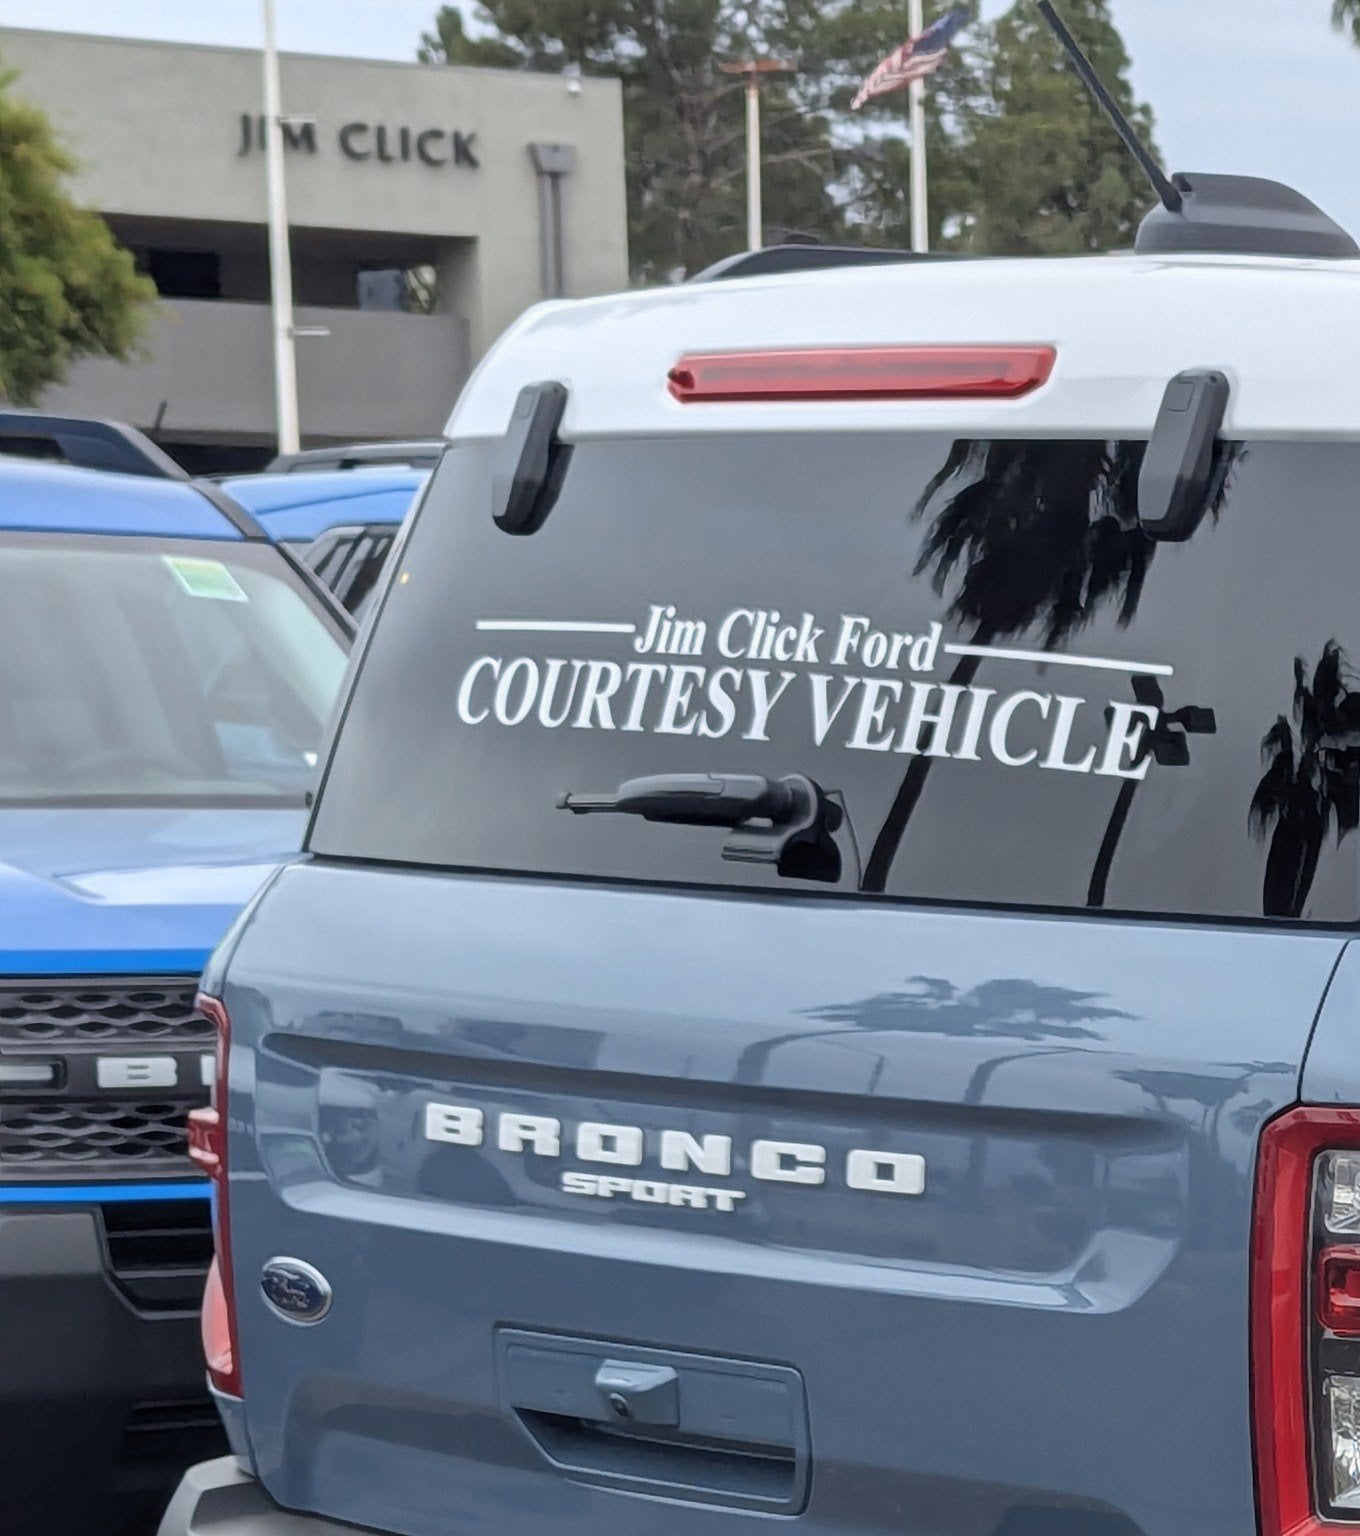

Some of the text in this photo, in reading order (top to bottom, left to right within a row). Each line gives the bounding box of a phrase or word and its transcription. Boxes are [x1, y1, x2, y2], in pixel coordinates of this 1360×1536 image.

[238, 114, 479, 168] JIM CLICK
[634, 604, 942, 672] Jim Click Ford
[457, 656, 1159, 780] COURTESY VEHICLE
[425, 1102, 925, 1195] BRONCO
[561, 1171, 746, 1212] SPORT
